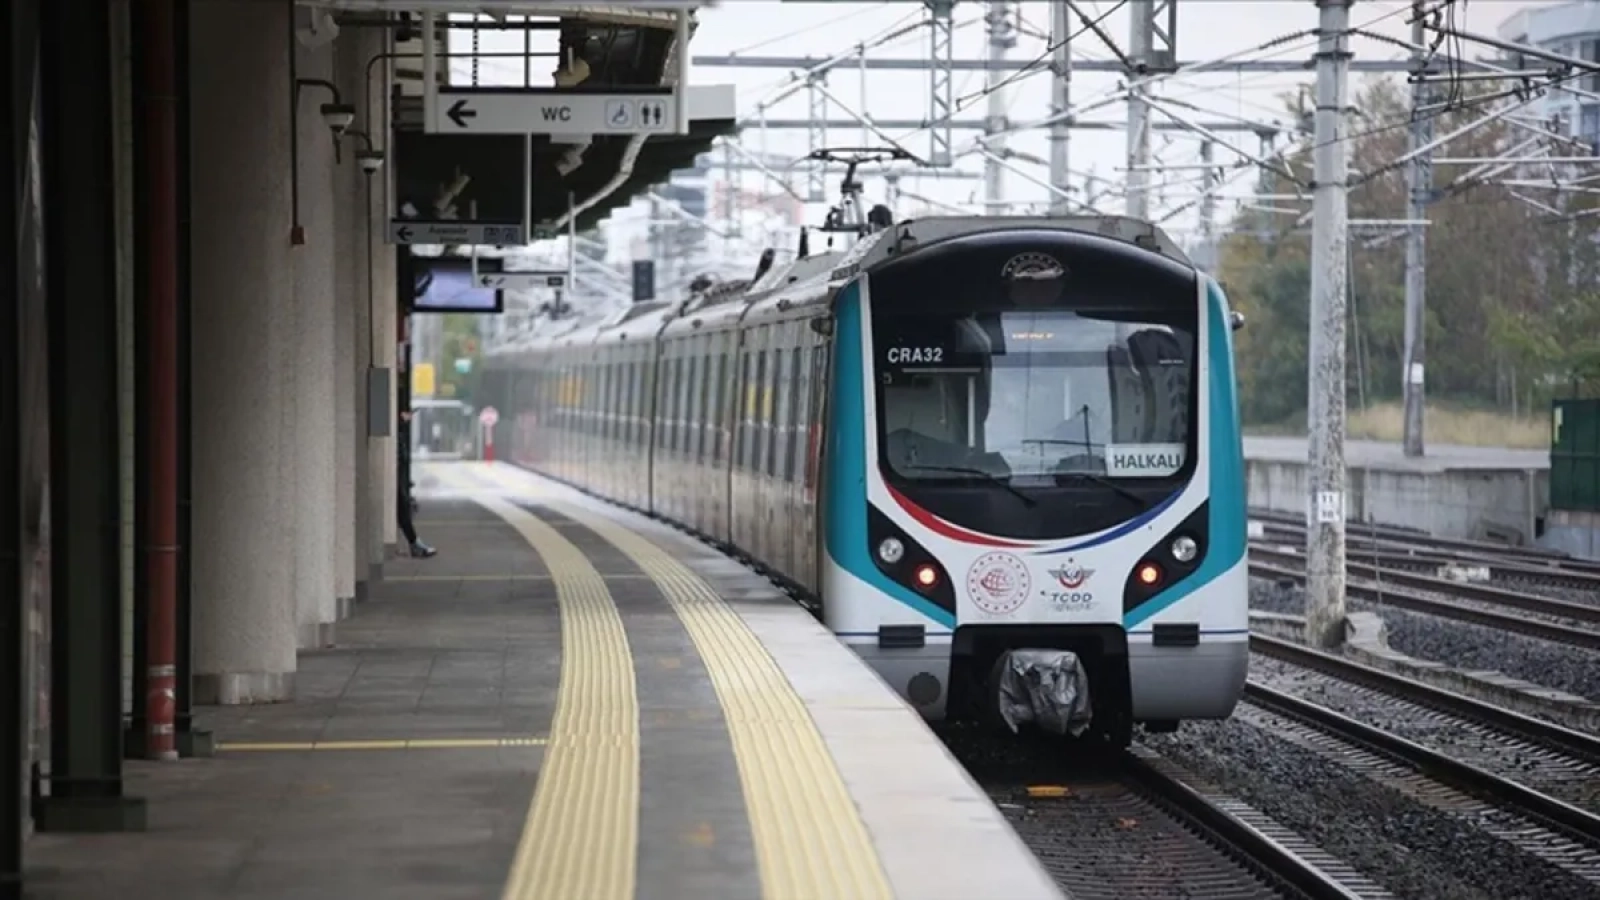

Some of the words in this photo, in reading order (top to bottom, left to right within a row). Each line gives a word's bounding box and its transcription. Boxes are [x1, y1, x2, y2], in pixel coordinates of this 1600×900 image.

[541, 106, 571, 121] WC
[888, 347, 943, 362] CRA32
[1114, 454, 1181, 469] HALKALI
[1051, 592, 1093, 603] TCDD
